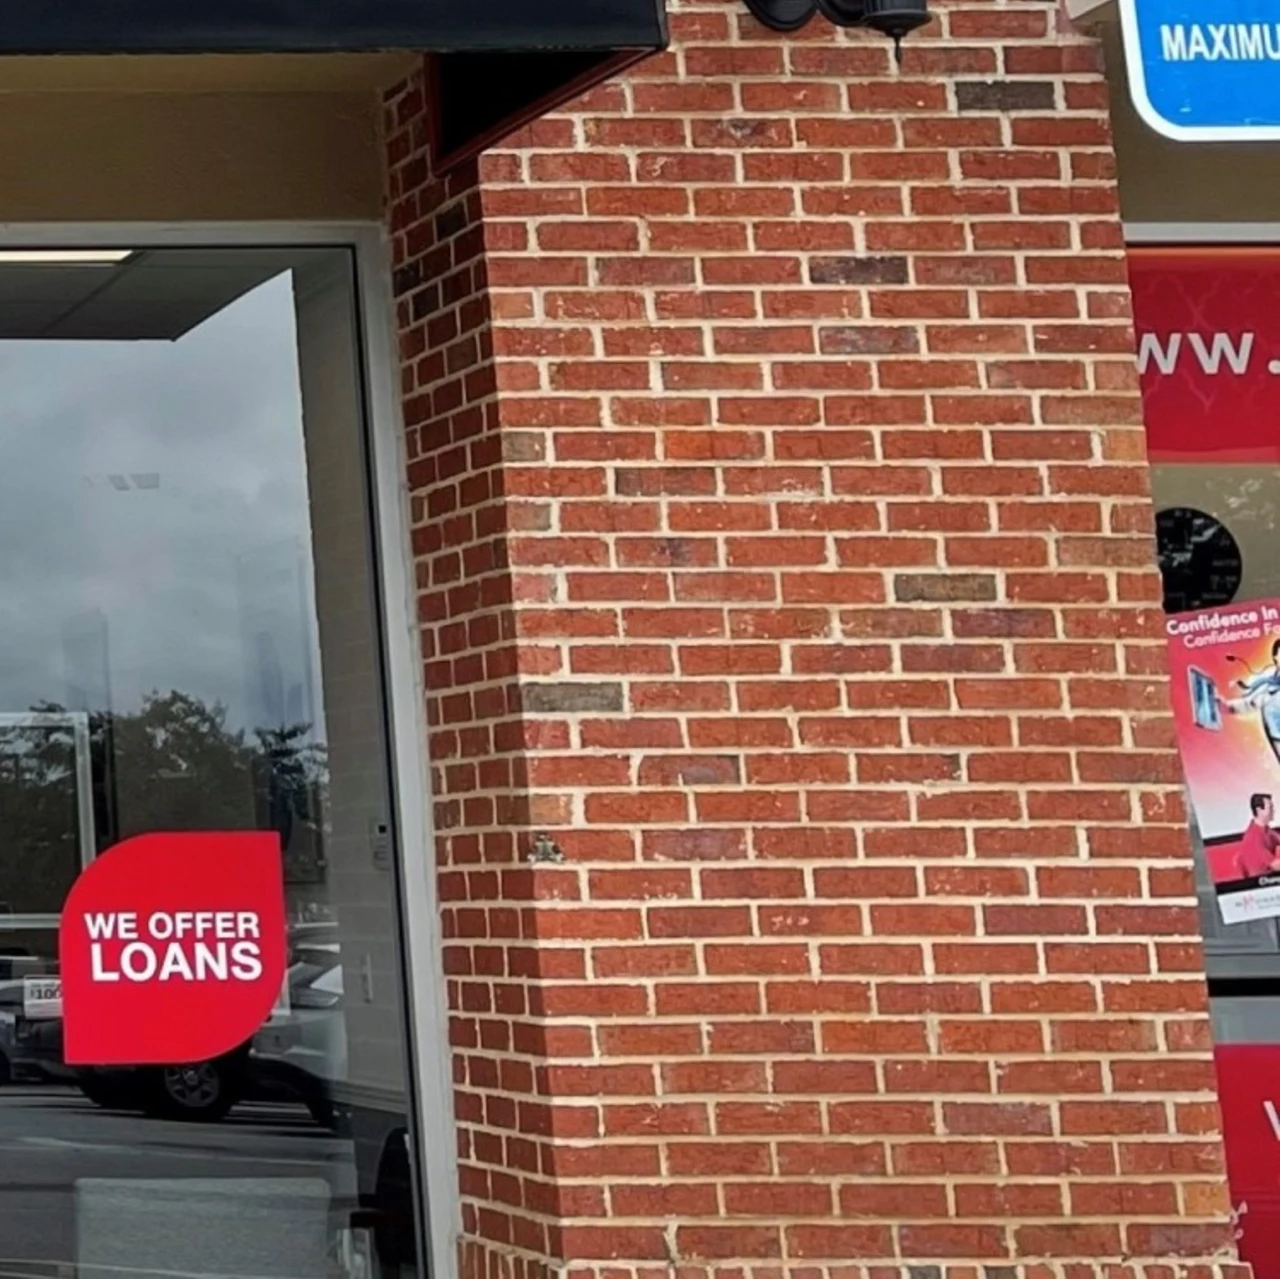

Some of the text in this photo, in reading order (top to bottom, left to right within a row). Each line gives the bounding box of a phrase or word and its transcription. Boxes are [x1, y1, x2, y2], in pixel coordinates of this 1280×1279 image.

[1161, 23, 1280, 61] MAXIMU
[1166, 611, 1258, 635] Confidence
[1183, 627, 1261, 648] Confidence
[84, 911, 260, 940] WE OFFER
[91, 941, 263, 982] LOANS
